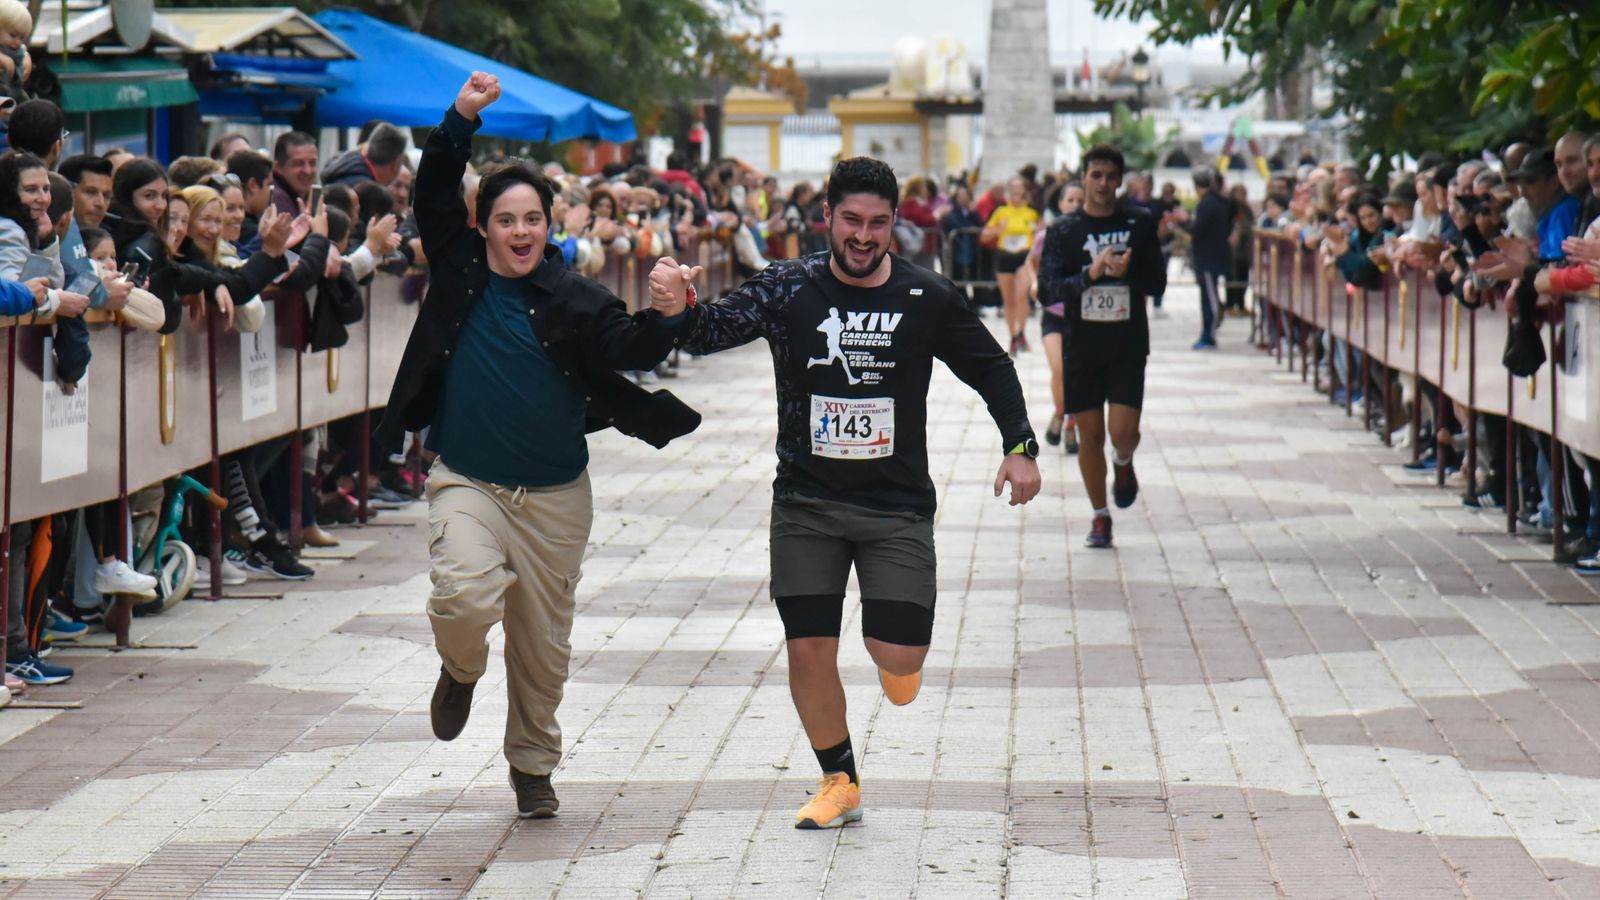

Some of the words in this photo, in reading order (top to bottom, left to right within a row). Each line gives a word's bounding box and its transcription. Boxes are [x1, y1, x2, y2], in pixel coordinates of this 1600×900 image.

[1098, 231, 1131, 245] XIV
[1098, 295, 1114, 309] 20
[846, 311, 903, 331] XIV
[862, 372, 870, 380] 8
[824, 401, 849, 415] XIV
[831, 414, 873, 439] 143
